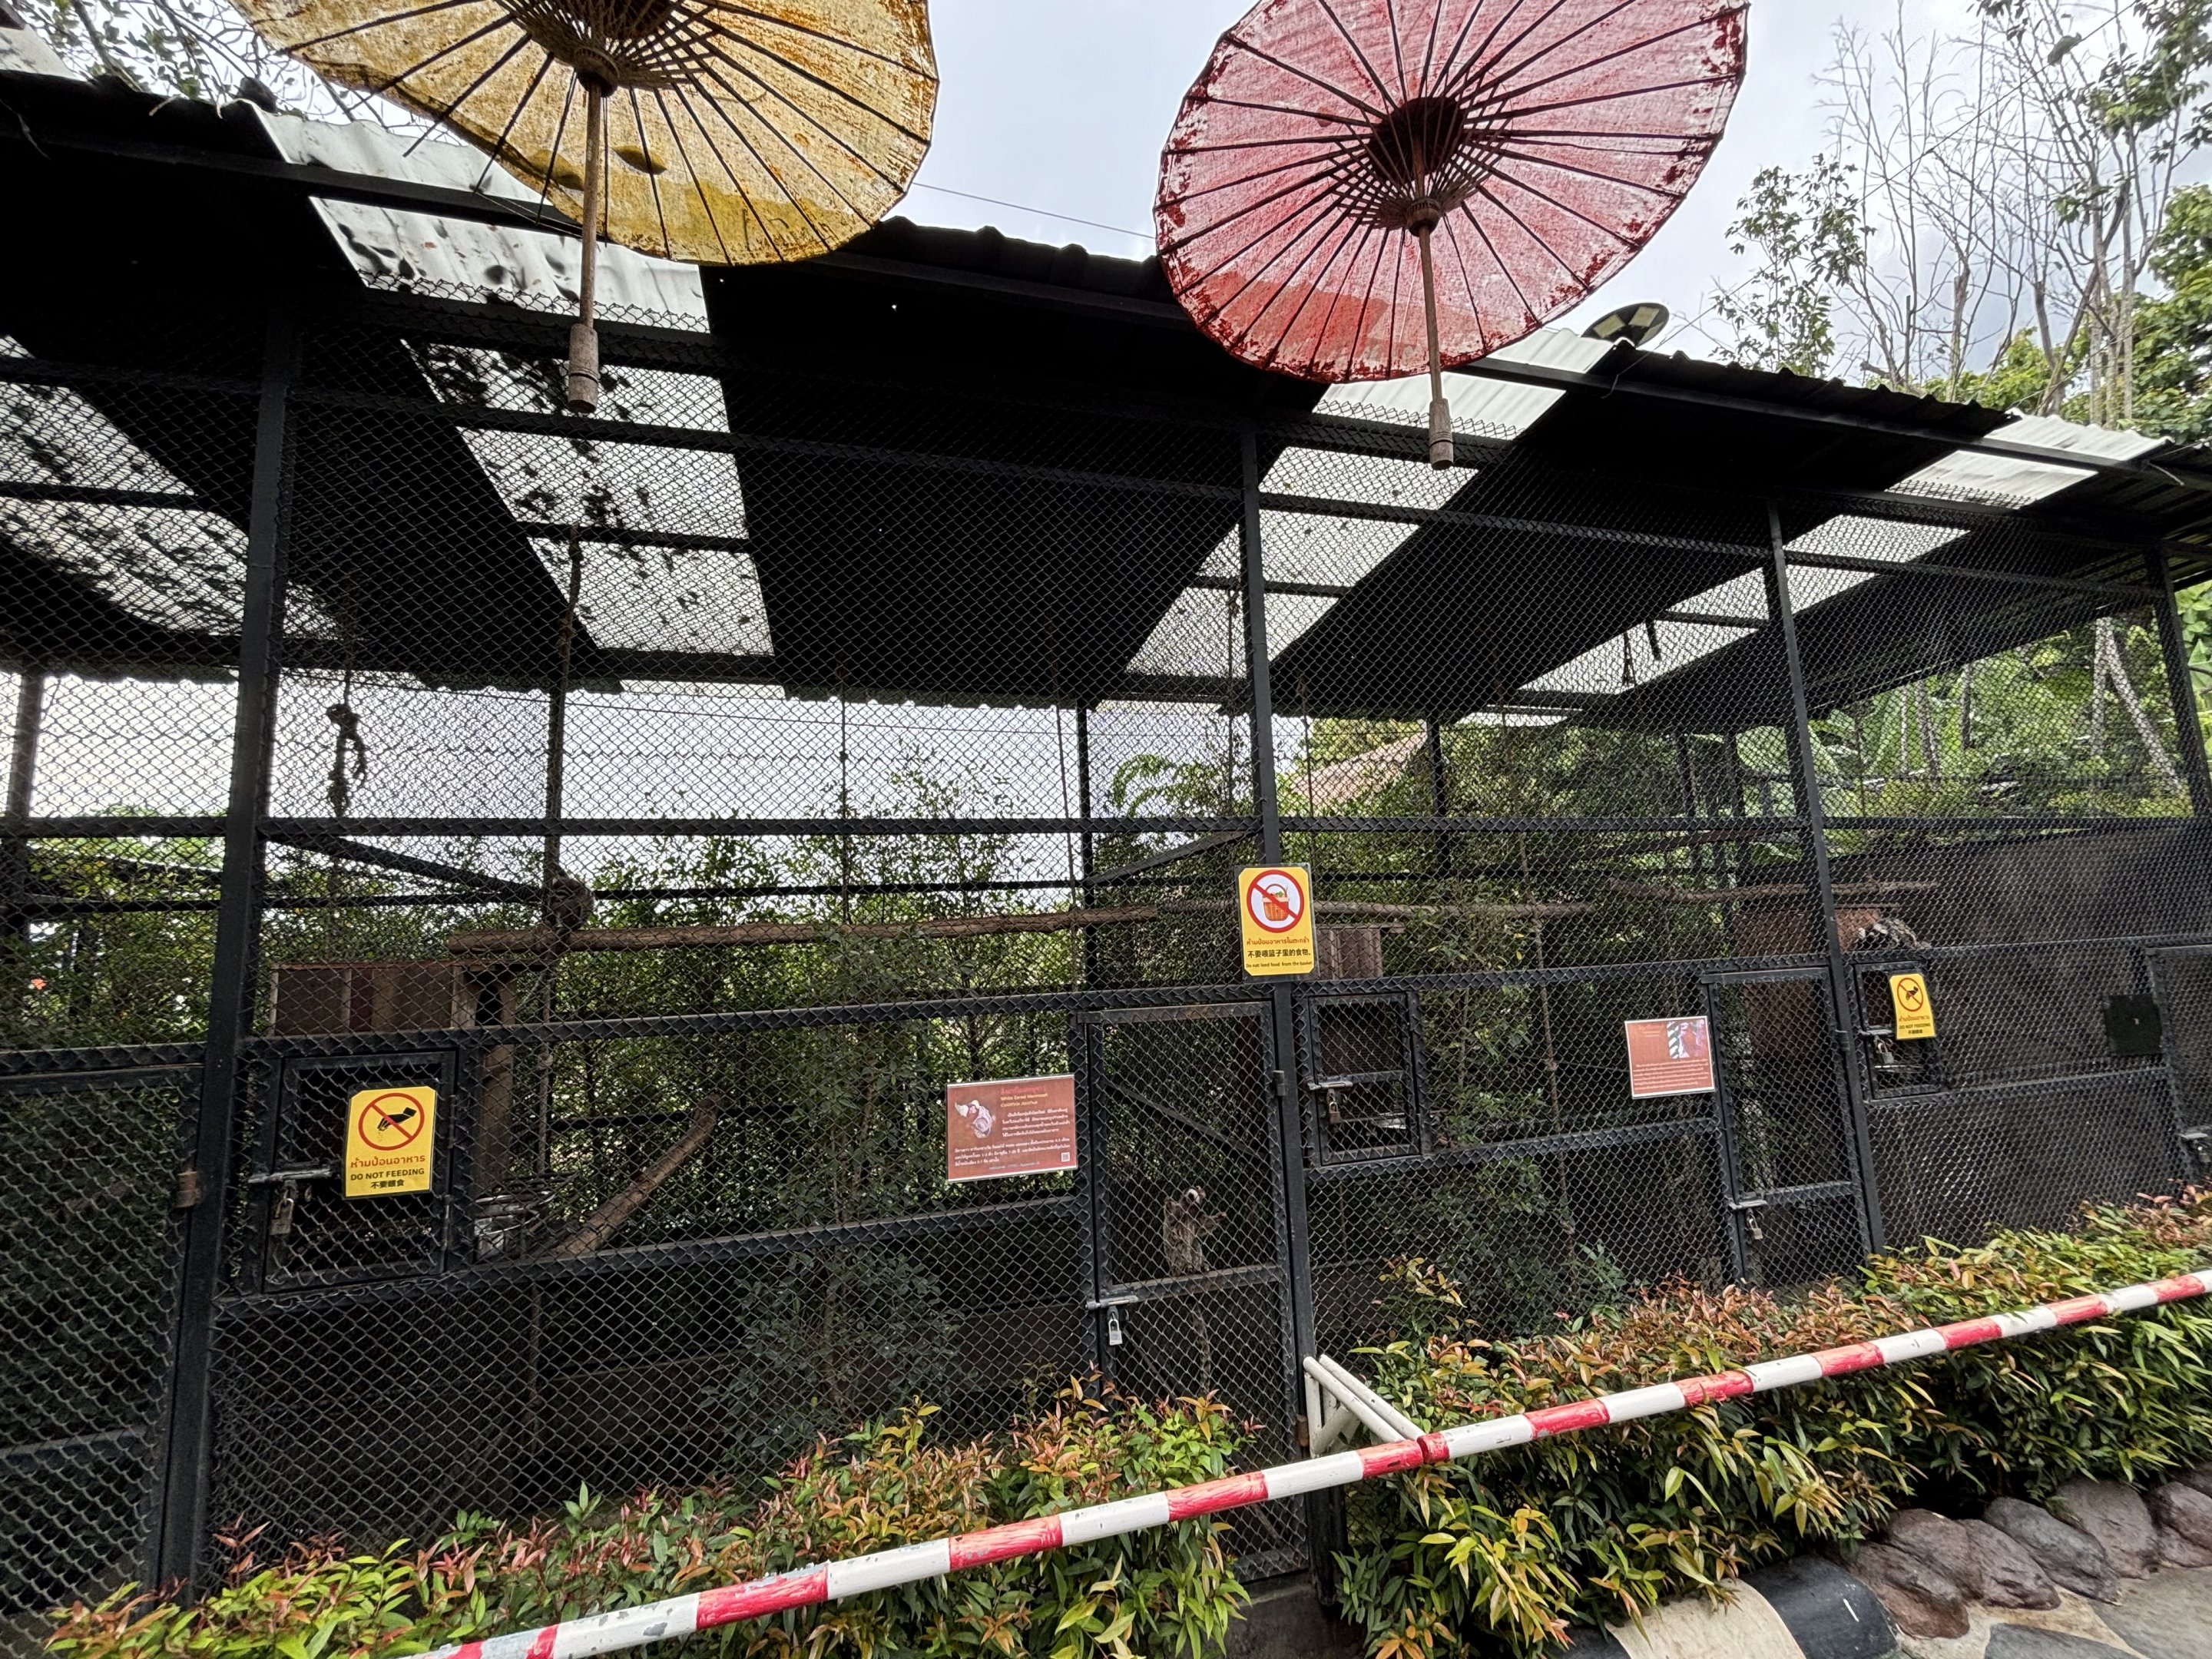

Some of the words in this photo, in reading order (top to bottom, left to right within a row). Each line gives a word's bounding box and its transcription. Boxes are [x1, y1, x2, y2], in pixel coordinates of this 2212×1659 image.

[350, 1155, 426, 1167] ห้ามป้อนอาหาร
[386, 1168, 425, 1177] FEEDING
